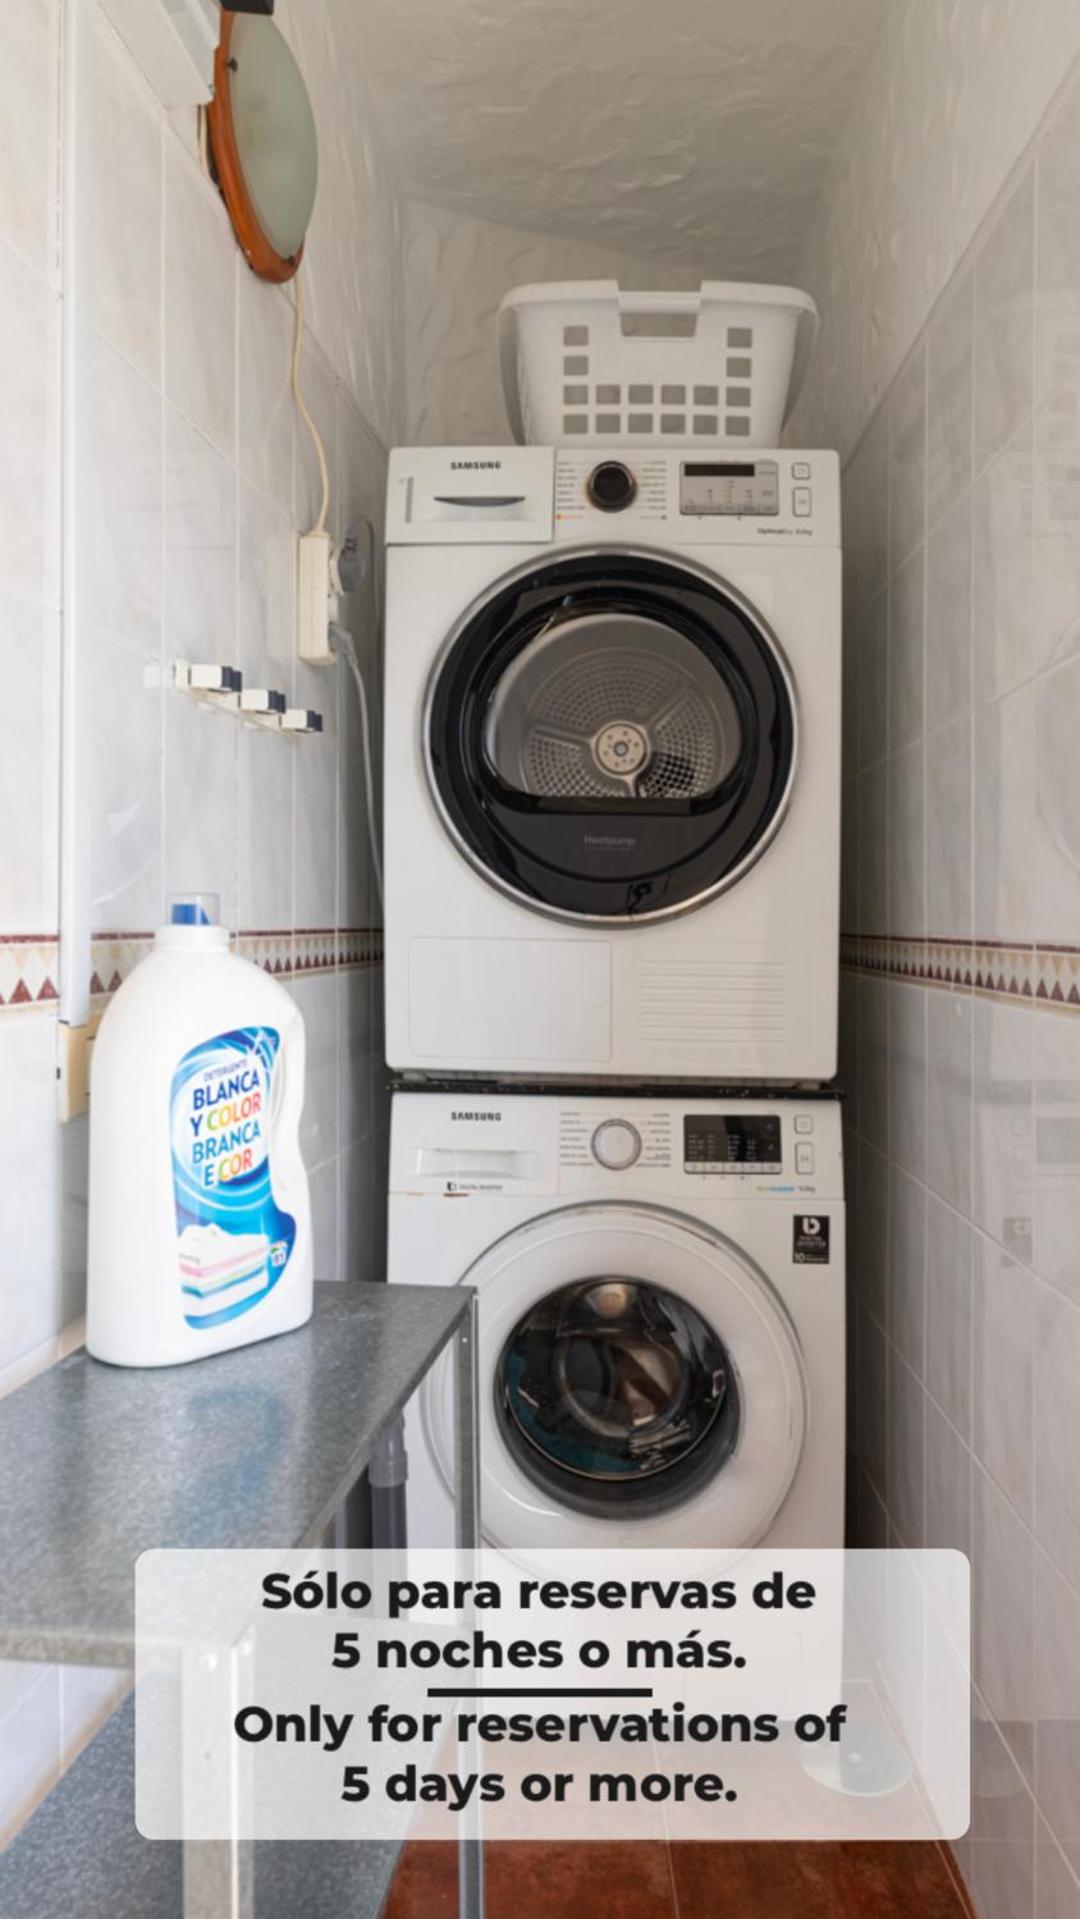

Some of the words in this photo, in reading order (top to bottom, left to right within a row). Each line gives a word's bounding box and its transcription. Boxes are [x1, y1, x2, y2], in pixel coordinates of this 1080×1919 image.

[450, 461, 502, 470] SAMSUNG
[193, 1068, 260, 1110] BLANCA
[203, 1058, 248, 1081] DETERGENTE
[190, 1114, 203, 1137] Y
[206, 1091, 262, 1131] COLOR
[450, 1111, 502, 1122] SAMSUNG
[192, 1118, 261, 1164] BRANCA
[204, 1163, 215, 1187] E
[218, 1148, 253, 1182] COR
